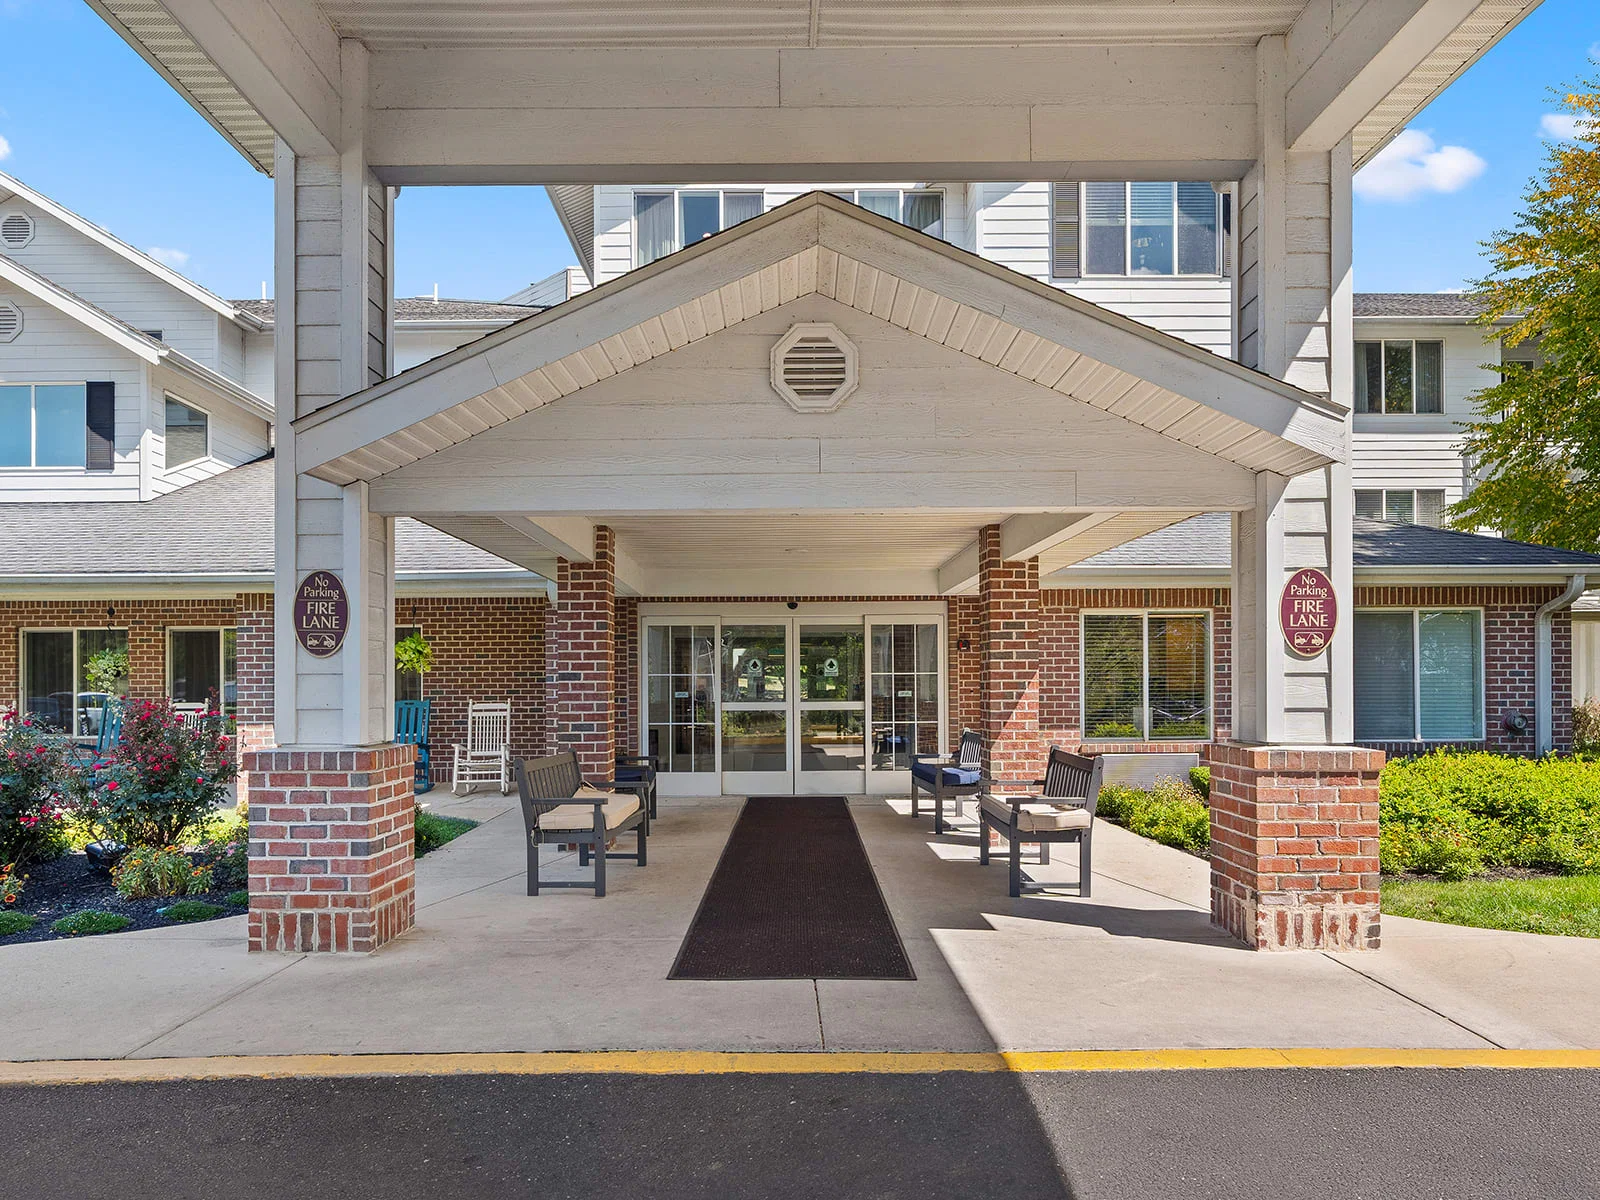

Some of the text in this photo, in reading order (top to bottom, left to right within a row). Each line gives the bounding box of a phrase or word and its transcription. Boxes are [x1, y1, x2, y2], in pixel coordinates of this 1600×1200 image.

[314, 576, 329, 587] No
[1301, 574, 1317, 585] No
[303, 586, 339, 600] Parking
[1290, 584, 1328, 598] Parking
[307, 601, 337, 614] FIRE
[1294, 599, 1324, 612] FIRE
[302, 615, 340, 628] LANE
[1289, 613, 1329, 626] LANE
